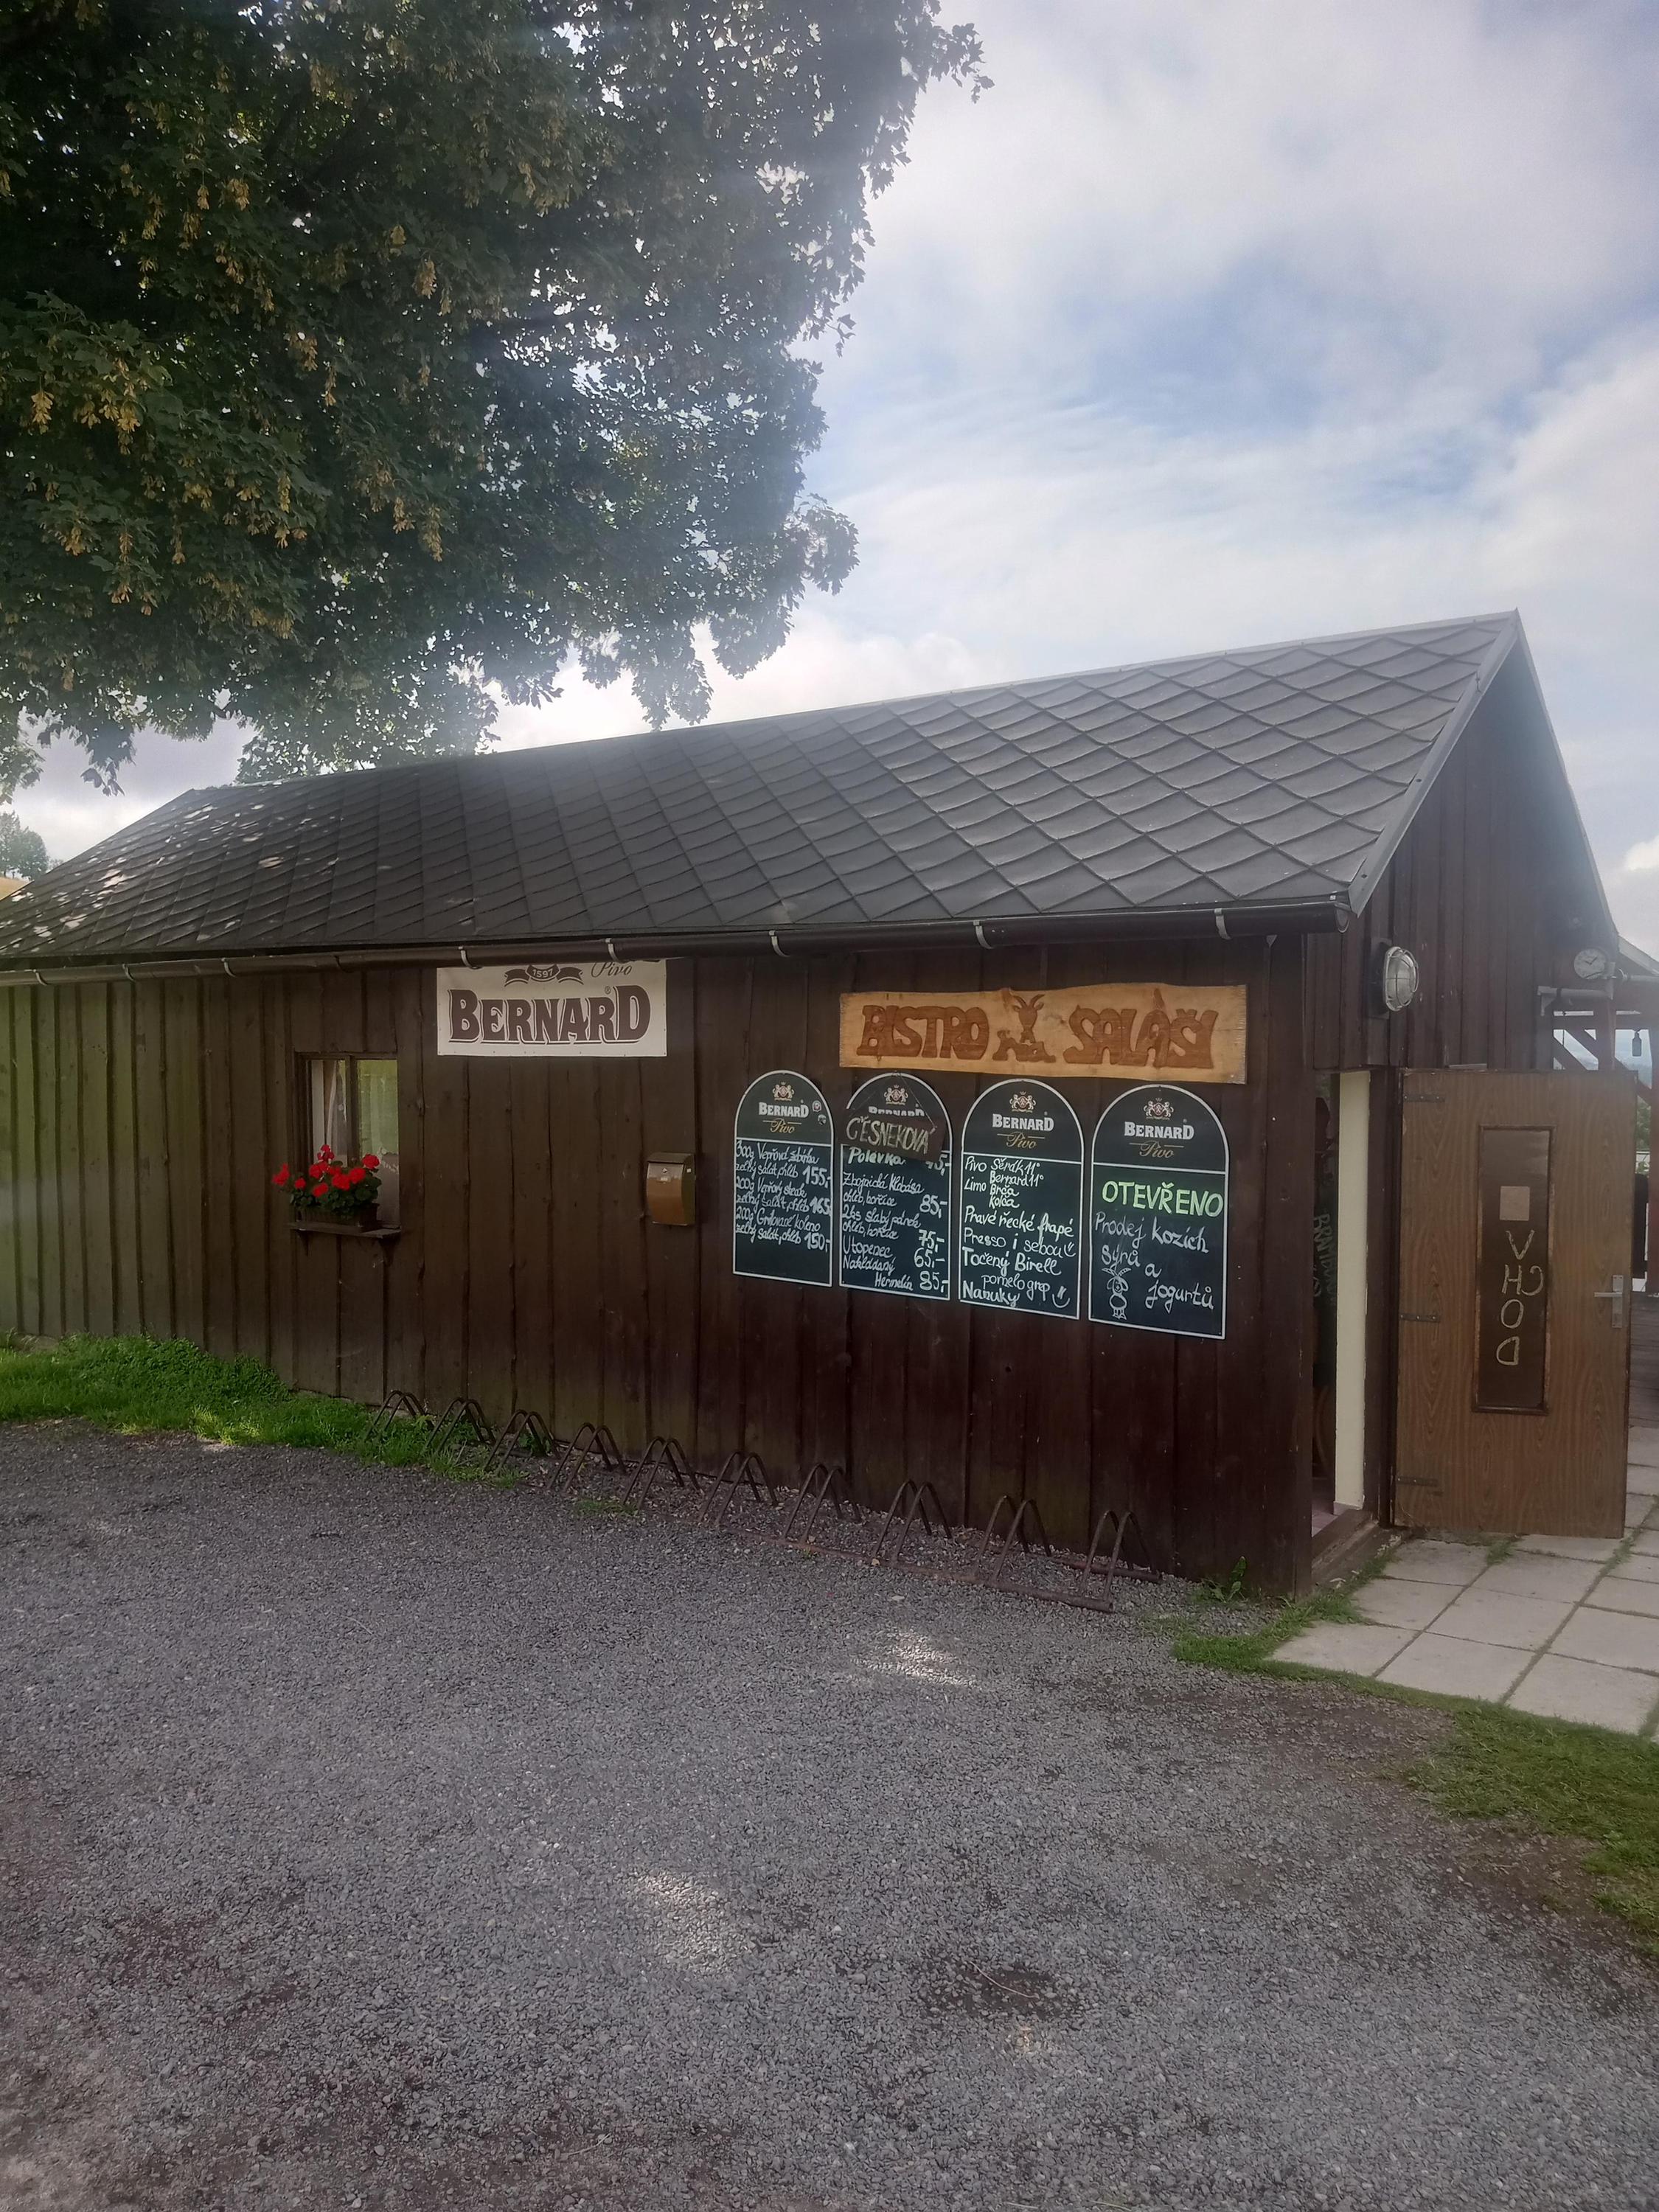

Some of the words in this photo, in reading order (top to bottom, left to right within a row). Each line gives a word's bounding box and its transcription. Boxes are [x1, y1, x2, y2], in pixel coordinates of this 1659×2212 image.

[531, 968, 554, 978] 1597
[591, 961, 632, 978] Pivo
[447, 984, 651, 1044] BERNARD
[856, 1004, 990, 1061] BISTRO
[758, 1102, 810, 1119] BERNARD
[770, 1118, 795, 1133] Pivo
[992, 1113, 1054, 1132] BERNARD
[1124, 1121, 1194, 1140] BERNARD
[1006, 1131, 1037, 1149] Pivo
[1139, 1140, 1175, 1158] Pivo
[964, 1155, 987, 1172] Pivo
[964, 1176, 987, 1192] Limo
[1102, 1180, 1224, 1217] OTEVŘENO
[964, 1227, 1006, 1247] Presso
[1095, 1211, 1147, 1249] Prodej
[1144, 1263, 1162, 1278] a
[1145, 1279, 1214, 1314] jogurtů
